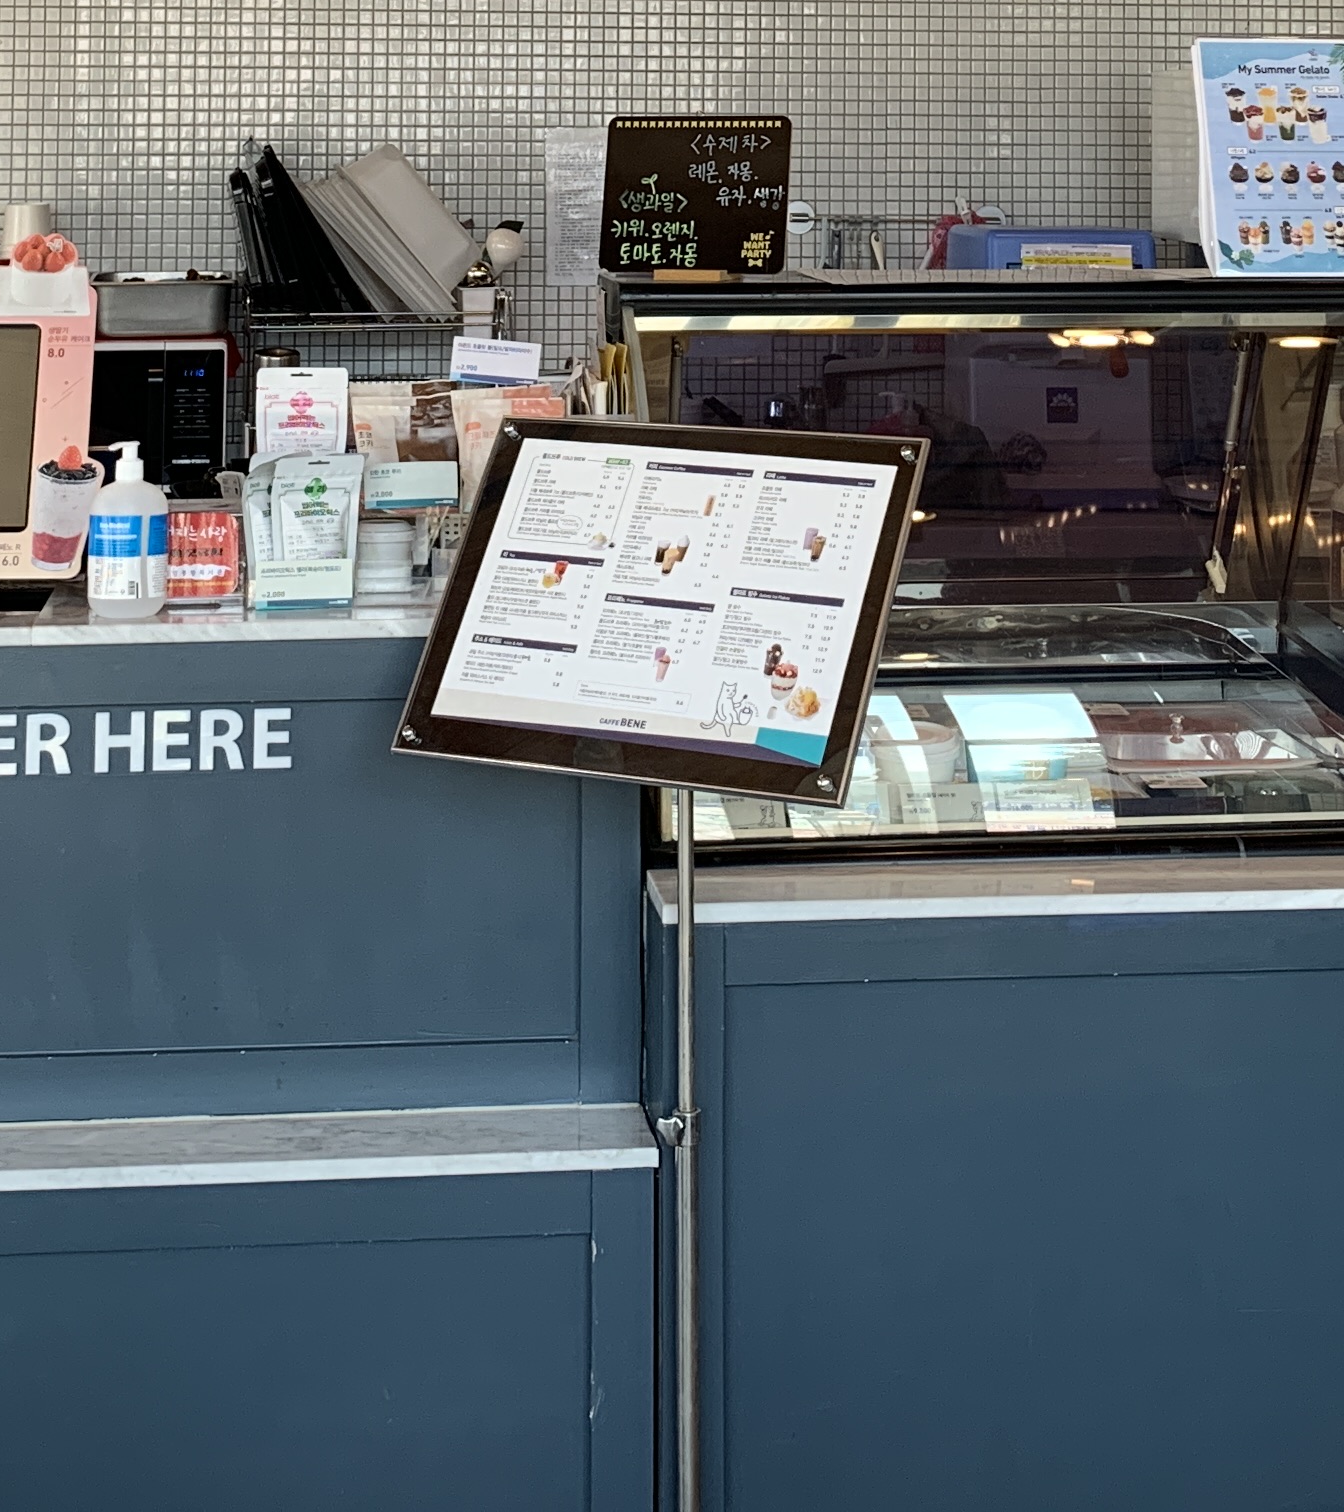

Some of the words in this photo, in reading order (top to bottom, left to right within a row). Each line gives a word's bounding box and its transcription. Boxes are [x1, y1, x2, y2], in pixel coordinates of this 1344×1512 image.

[1238, 65, 1252, 75] My
[1255, 65, 1296, 74] Summer
[1299, 65, 1330, 74] Gelato
[744, 241, 770, 249] WANT
[741, 249, 771, 259] PARTY
[47, 348, 65, 358] 8.0
[2, 556, 19, 566] 6.0
[599, 717, 620, 726] CAFFE
[620, 718, 647, 730] BENE
[94, 708, 292, 773] HERE
